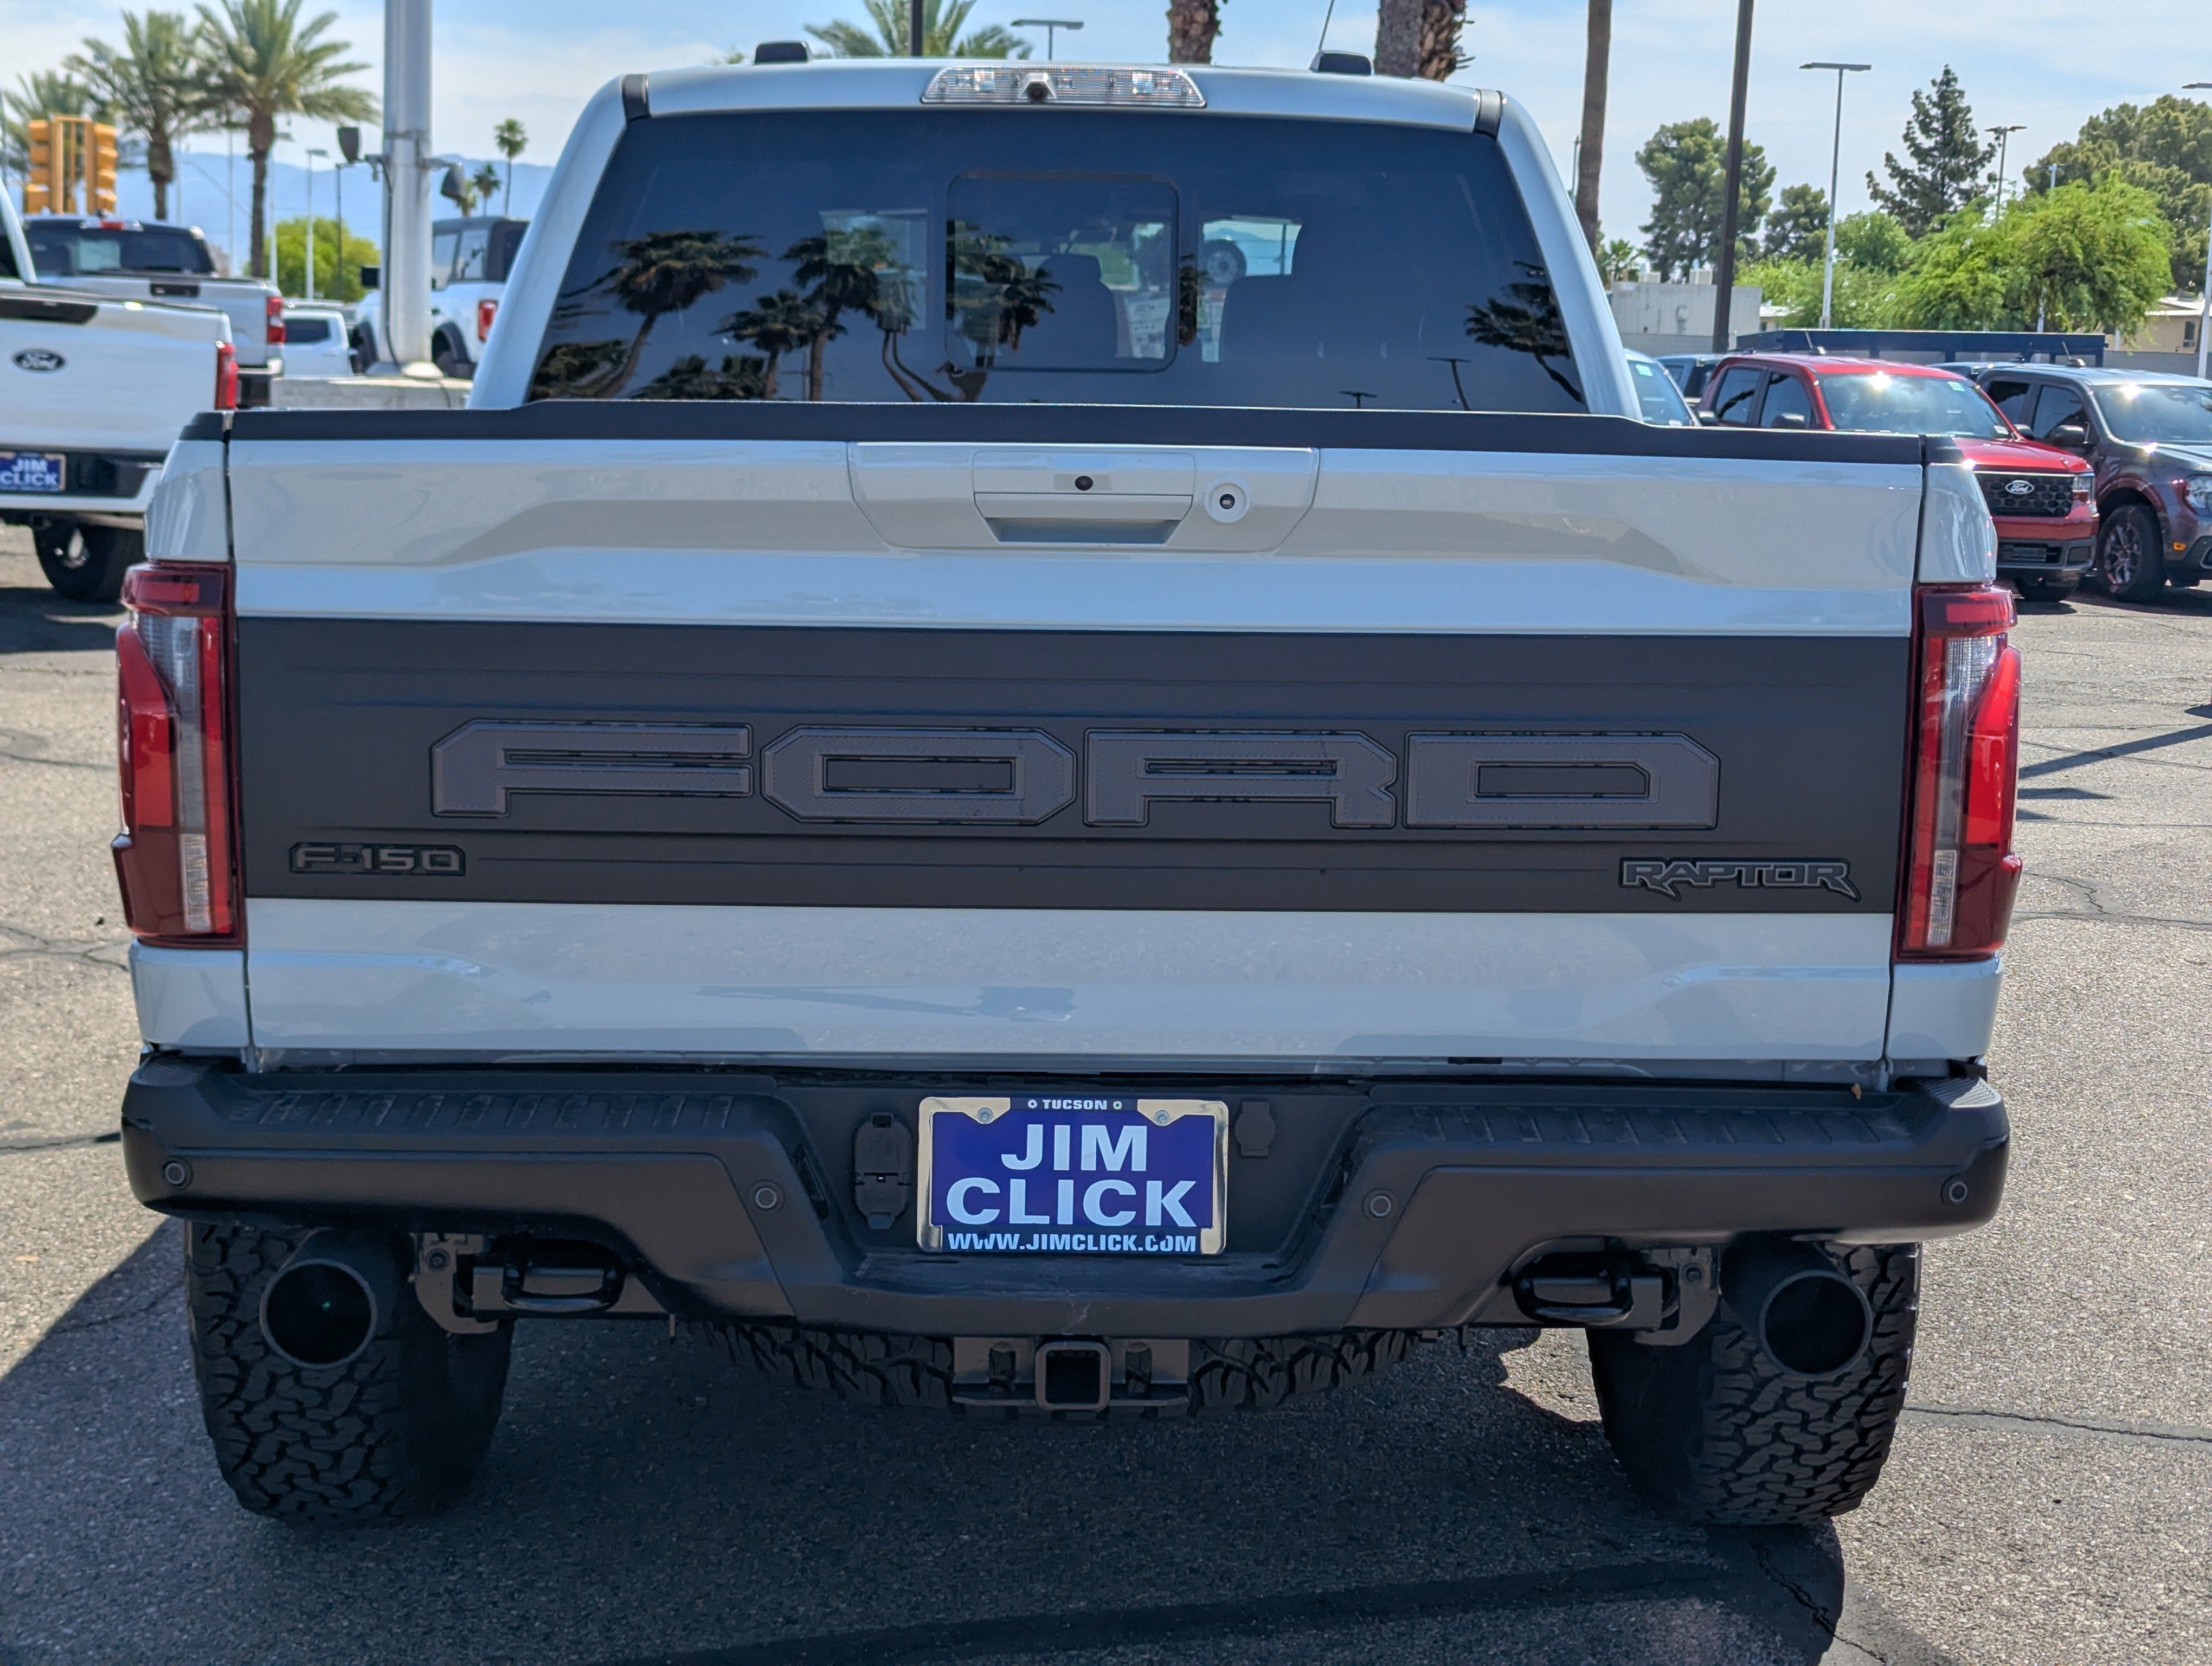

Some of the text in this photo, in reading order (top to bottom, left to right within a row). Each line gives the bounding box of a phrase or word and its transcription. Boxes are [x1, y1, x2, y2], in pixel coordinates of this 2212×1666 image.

[0, 470, 58, 485] CLICK
[11, 458, 48, 472] JIM
[432, 718, 1720, 830] FORD
[293, 844, 463, 873] F-150
[1620, 857, 1861, 901] RAPTOR
[1041, 1099, 1108, 1110] TUCSON
[1001, 1124, 1147, 1172] JIM
[946, 1177, 1197, 1227] CLICK
[947, 1233, 1197, 1252] WWW.JIMCLICK.COM
